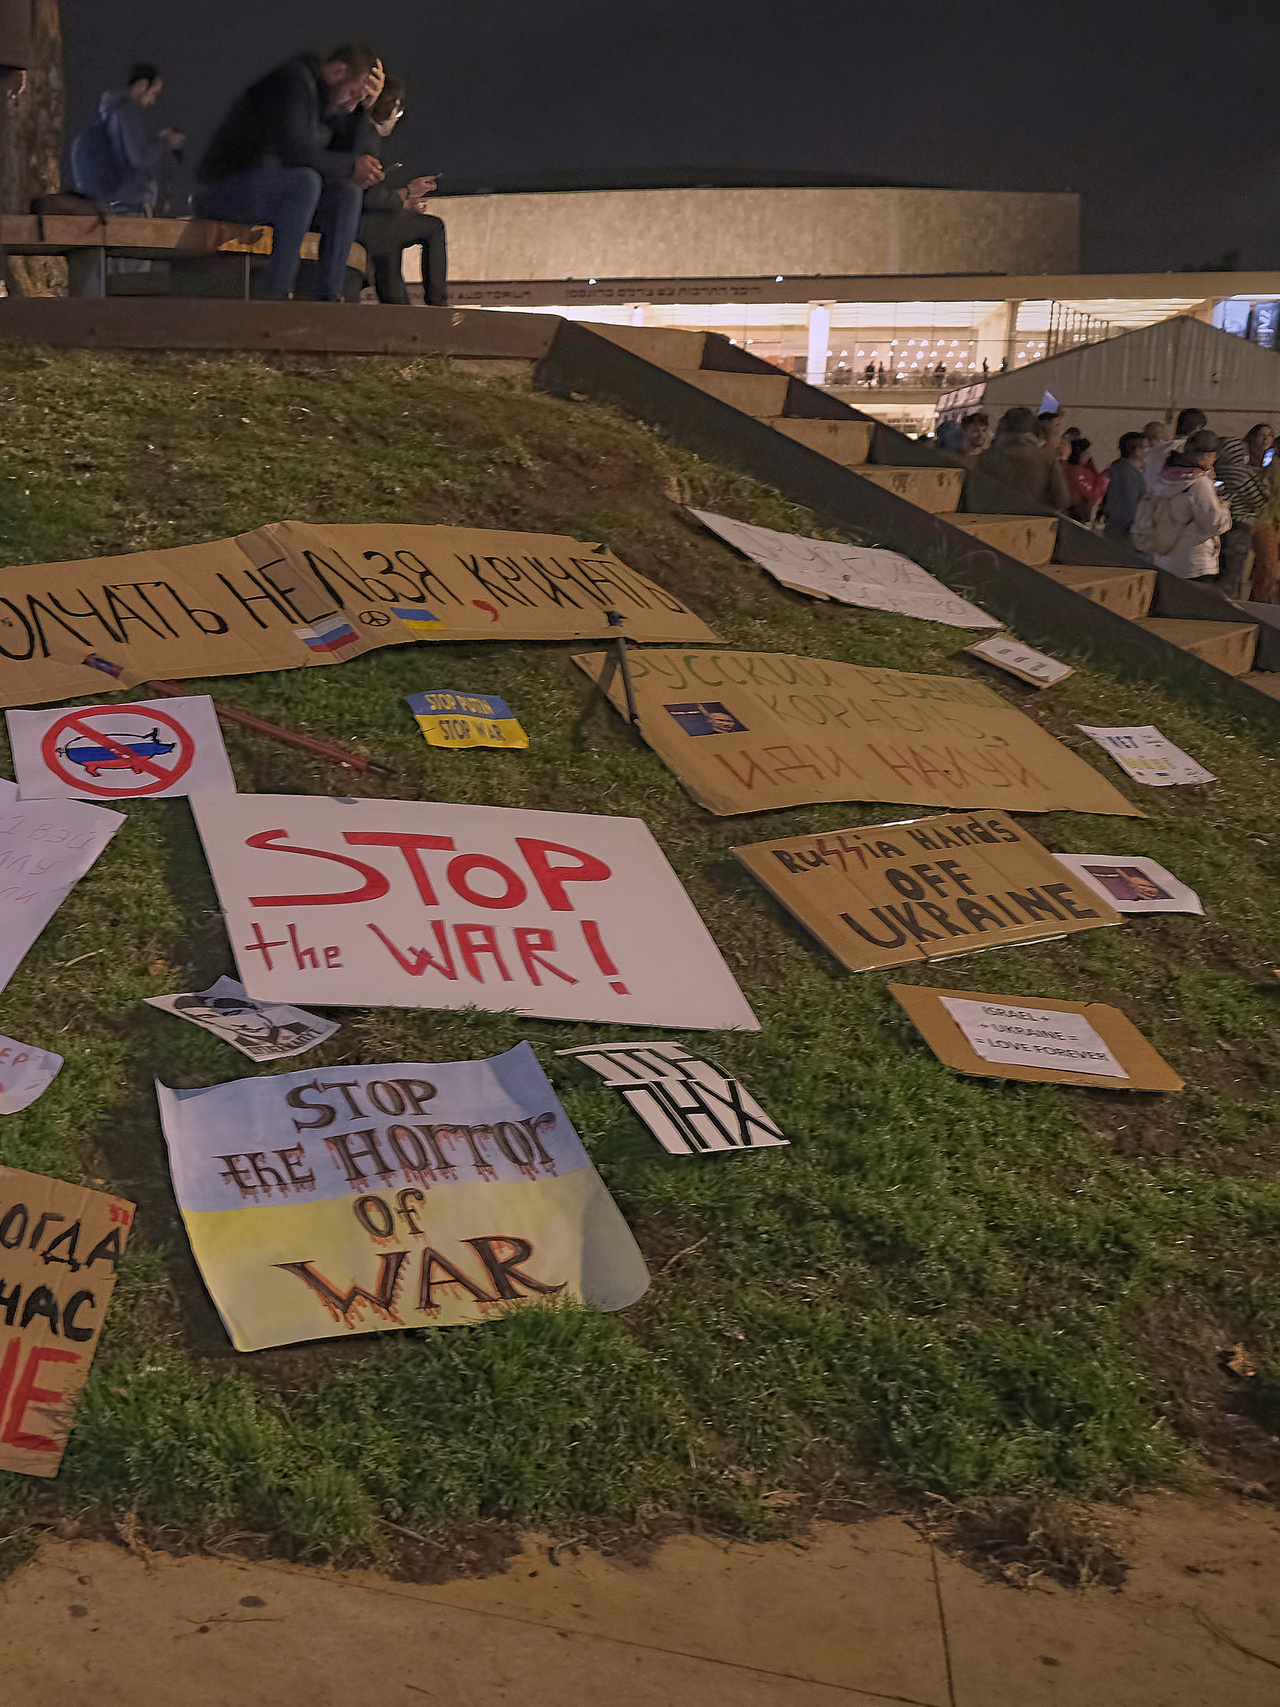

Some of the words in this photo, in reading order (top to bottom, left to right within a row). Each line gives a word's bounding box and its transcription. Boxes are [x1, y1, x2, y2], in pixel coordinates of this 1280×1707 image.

[455, 553, 687, 613] КРИЧАТЬ
[424, 693, 457, 711] STOP
[438, 719, 471, 741] STOP
[471, 719, 507, 741] WAR
[246, 829, 612, 911] STOP
[885, 859, 979, 902] OFF
[839, 882, 1100, 950] UKRAINE
[246, 922, 345, 971] the
[368, 919, 632, 995] WAR!
[980, 1005, 1039, 1021] ISRAEL
[991, 1023, 1067, 1041] UKRAINE
[987, 1038, 1032, 1052] LOVE
[1033, 1045, 1111, 1062] FOREVER
[285, 1077, 439, 1133] STOP
[270, 1235, 568, 1316] WAR
